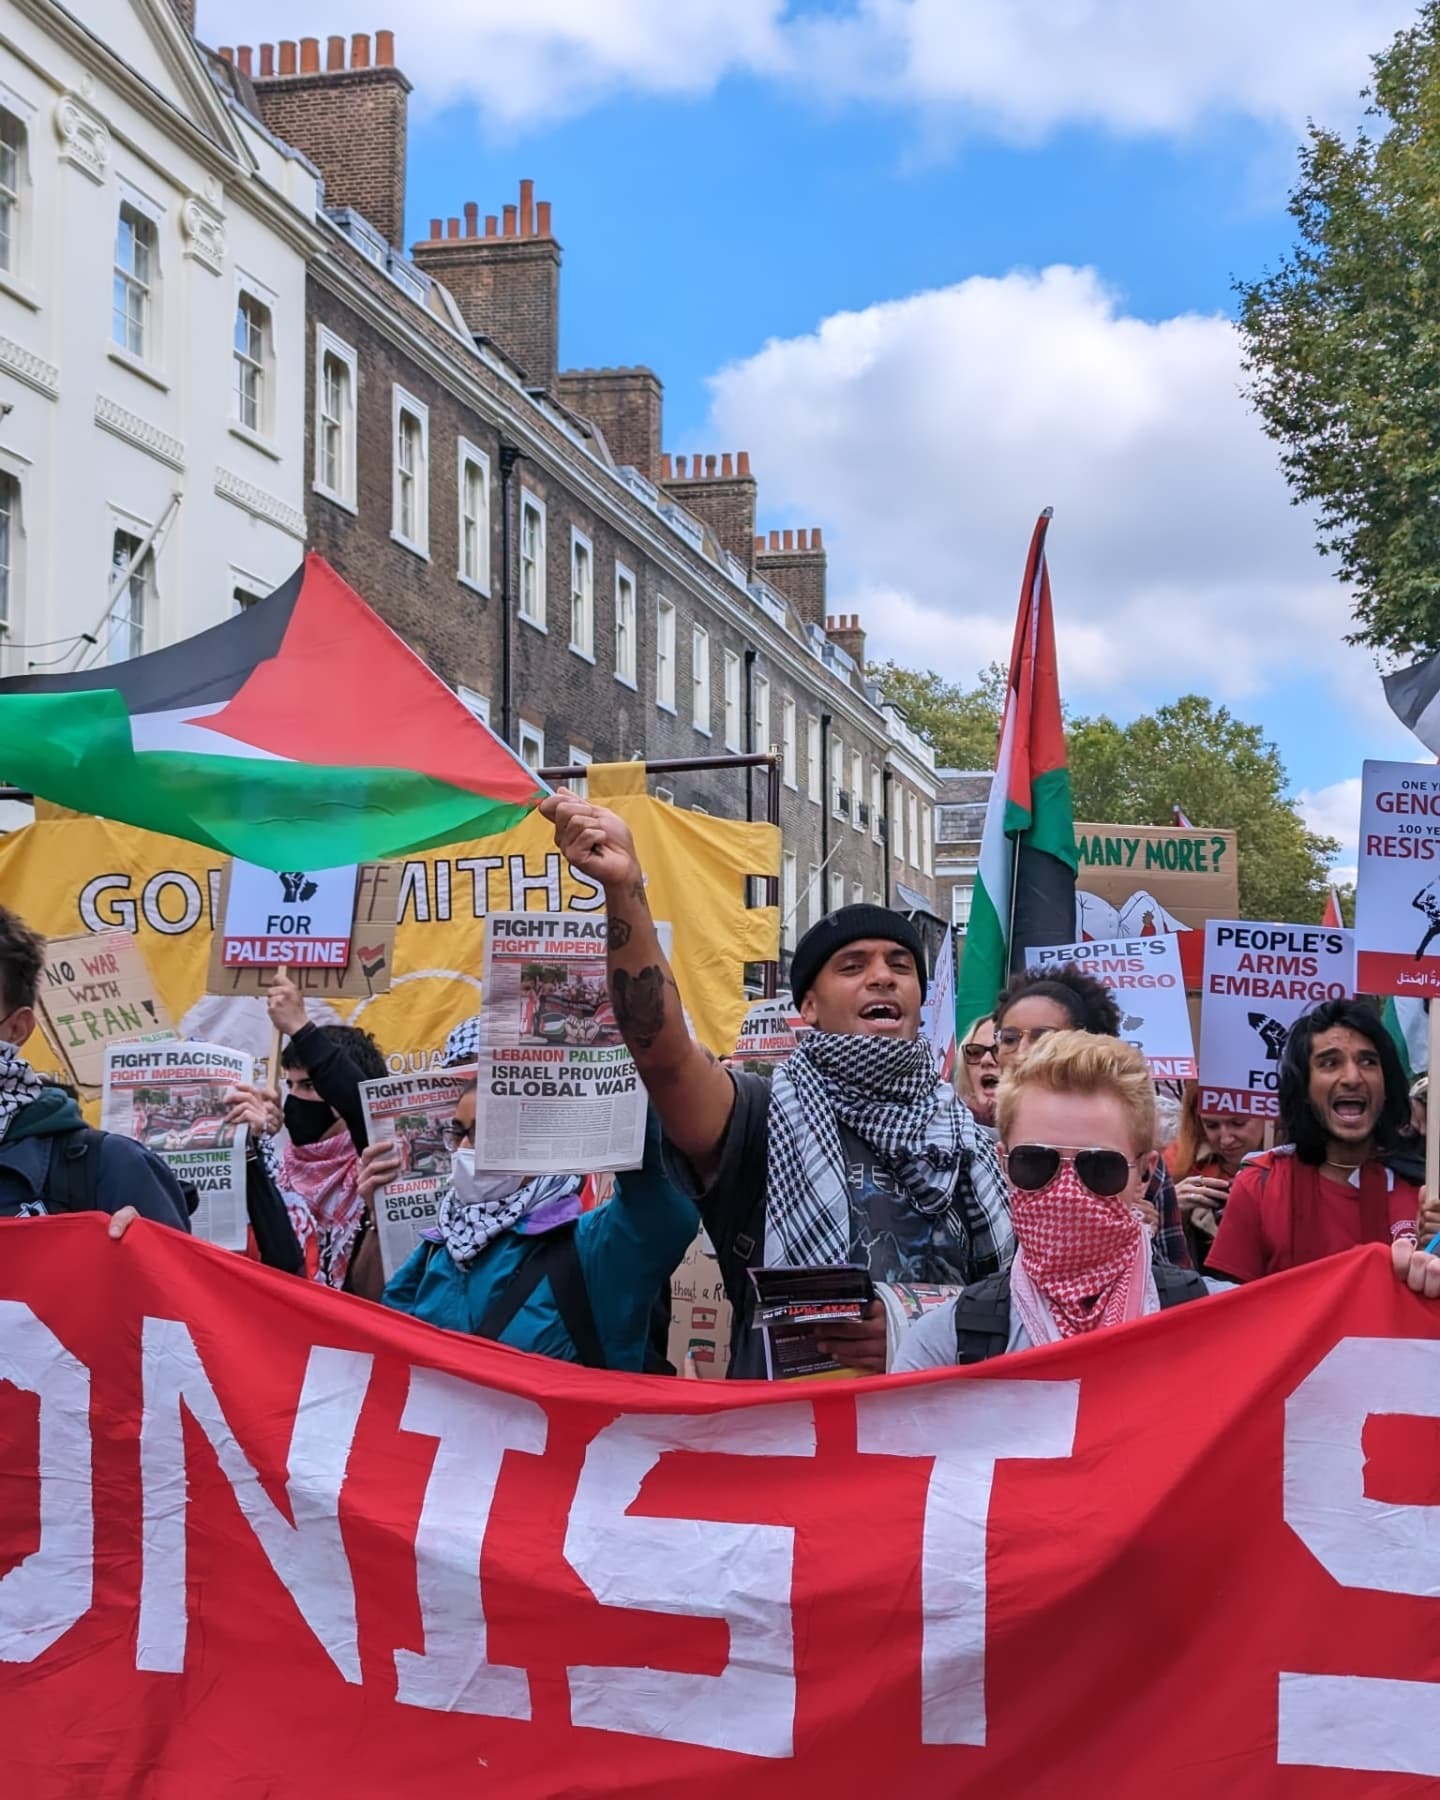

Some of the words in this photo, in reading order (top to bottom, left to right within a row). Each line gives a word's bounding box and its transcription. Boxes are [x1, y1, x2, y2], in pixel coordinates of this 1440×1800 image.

[1401, 780, 1428, 791] ONE
[1398, 824, 1422, 835] 100
[1074, 835, 1141, 868] MANY
[1145, 836, 1227, 872] MORE?
[1366, 834, 1440, 860] RESIS
[266, 915, 312, 935] FOR
[492, 919, 560, 937] FIGHT
[492, 940, 540, 953] FIGHT
[1217, 927, 1344, 954] PEOPLE'S
[225, 940, 346, 964] PALESTINE
[1040, 940, 1167, 963] PEOPLE'S
[44, 961, 75, 987] NO
[81, 953, 120, 976] WAR
[1077, 958, 1145, 975] RMS
[1237, 953, 1318, 977] ARMS
[67, 981, 121, 1004] WITH
[1209, 974, 1346, 1001] EMBARGO
[56, 1000, 160, 1047] IRAN!
[111, 1053, 162, 1069] FIGHT
[166, 1051, 243, 1072] RACISM!
[492, 1049, 565, 1063] LEBANON
[110, 1069, 147, 1082] FIGHT
[151, 1066, 242, 1082] IMPERIALISM!
[491, 1066, 553, 1080] ISRAEL
[558, 1062, 637, 1081] PROVOKES
[1149, 1060, 1192, 1075] NE
[365, 1080, 414, 1100] FIGHT
[490, 1081, 587, 1097] GLOBAL
[595, 1077, 637, 1096] WAR
[368, 1098, 403, 1112] FIGHT
[167, 1150, 232, 1165] PALESTINE
[384, 1178, 437, 1196] LEBANON
[384, 1192, 432, 1210] ISRAEL
